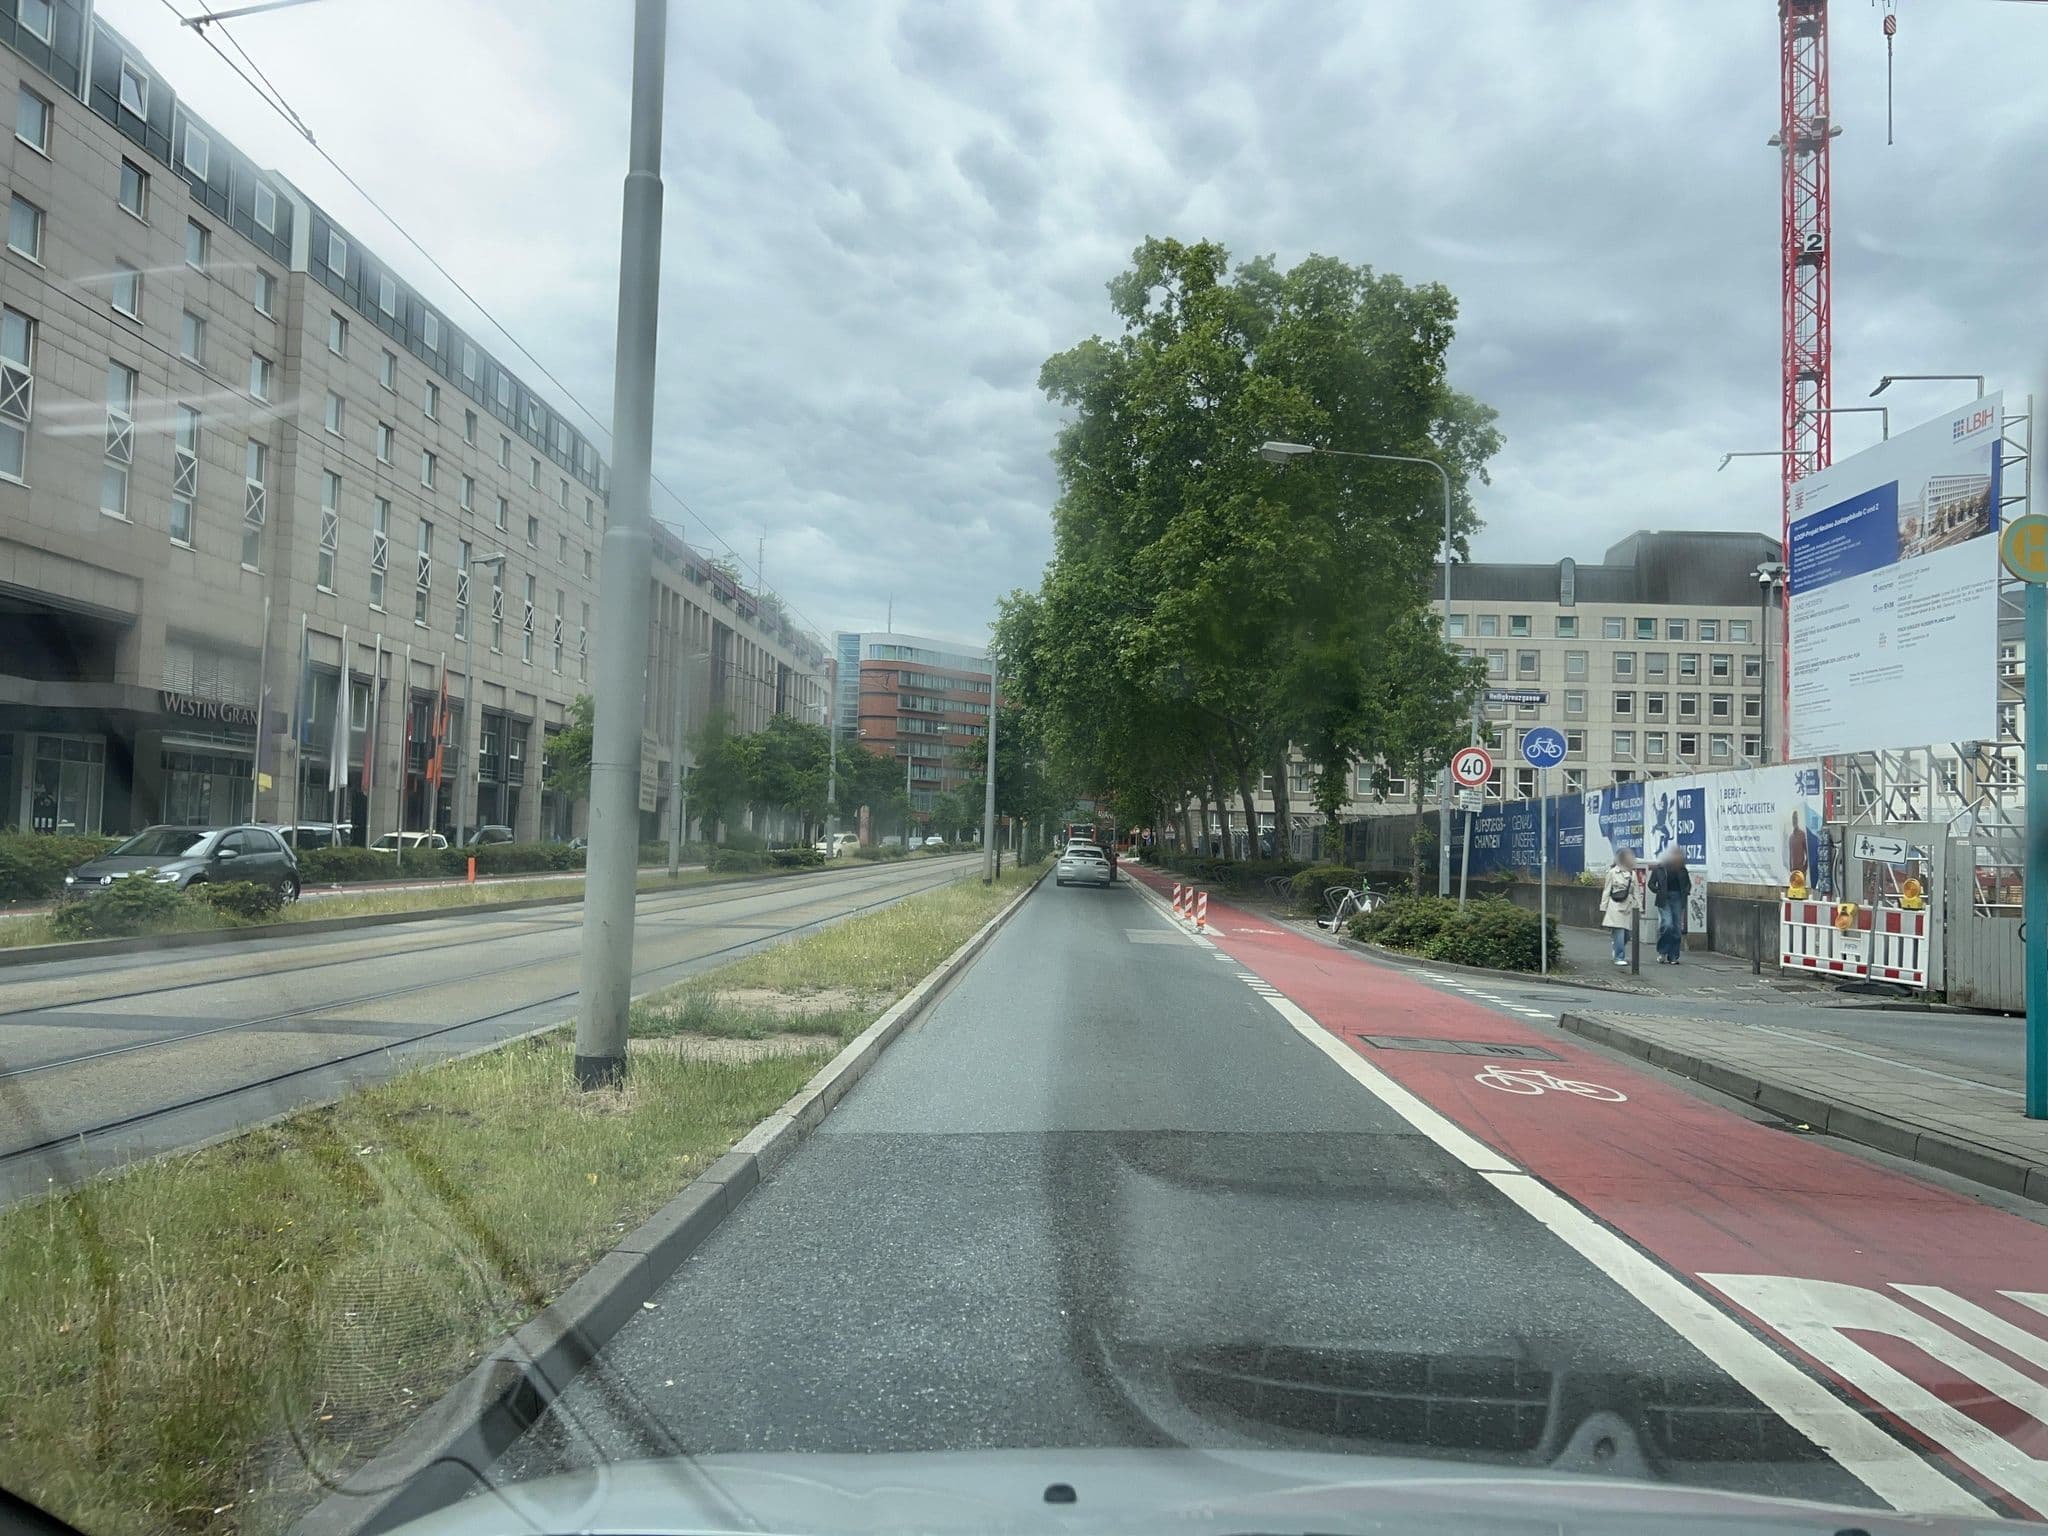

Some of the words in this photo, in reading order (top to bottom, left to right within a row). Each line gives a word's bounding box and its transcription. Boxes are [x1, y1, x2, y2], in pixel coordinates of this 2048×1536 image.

[1806, 234, 1822, 251] 2
[1966, 405, 1994, 433] LBIH
[163, 691, 217, 720] WESTIN
[220, 703, 259, 726] GRAN
[1460, 758, 1484, 776] 40
[1678, 794, 1692, 809] WIR
[1727, 802, 1776, 816] MÖGLICHKEITEN
[1678, 820, 1695, 834] SIND
[1511, 850, 1544, 866] BAUSTELL
[1680, 844, 1705, 860] STIZ.
